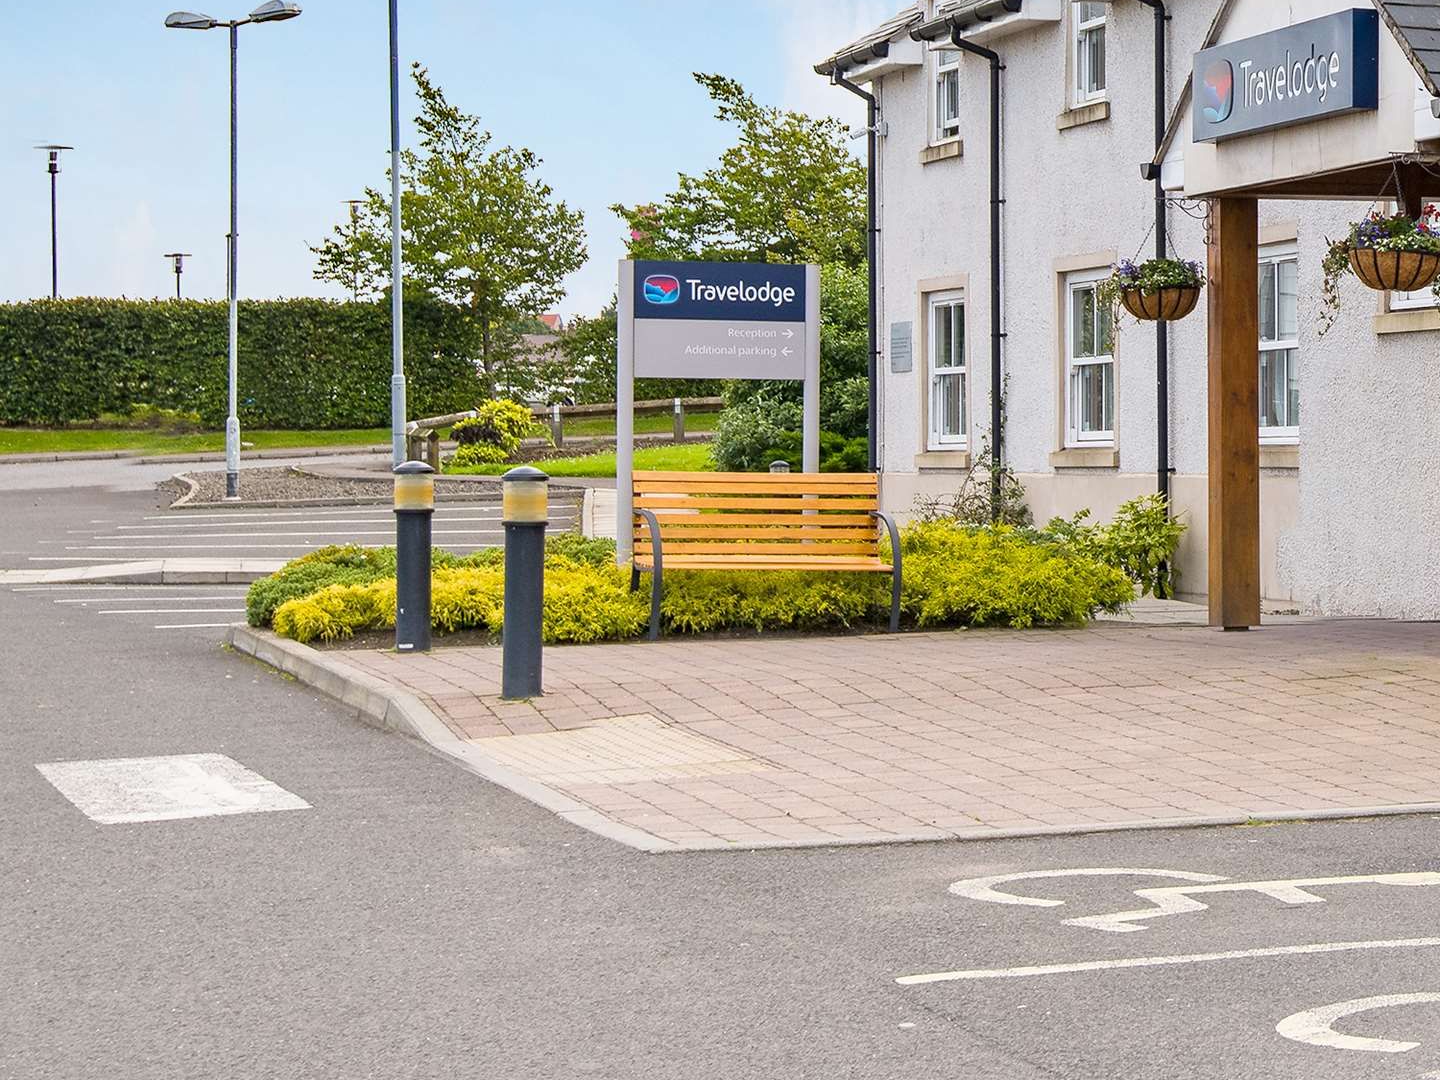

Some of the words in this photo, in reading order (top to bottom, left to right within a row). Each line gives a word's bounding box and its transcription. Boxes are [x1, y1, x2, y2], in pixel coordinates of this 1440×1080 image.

[1239, 43, 1340, 109] Travelodge
[686, 279, 796, 307] Travelodge
[727, 328, 777, 339] Reception
[685, 345, 736, 356] Additional
[738, 345, 777, 358] parking
